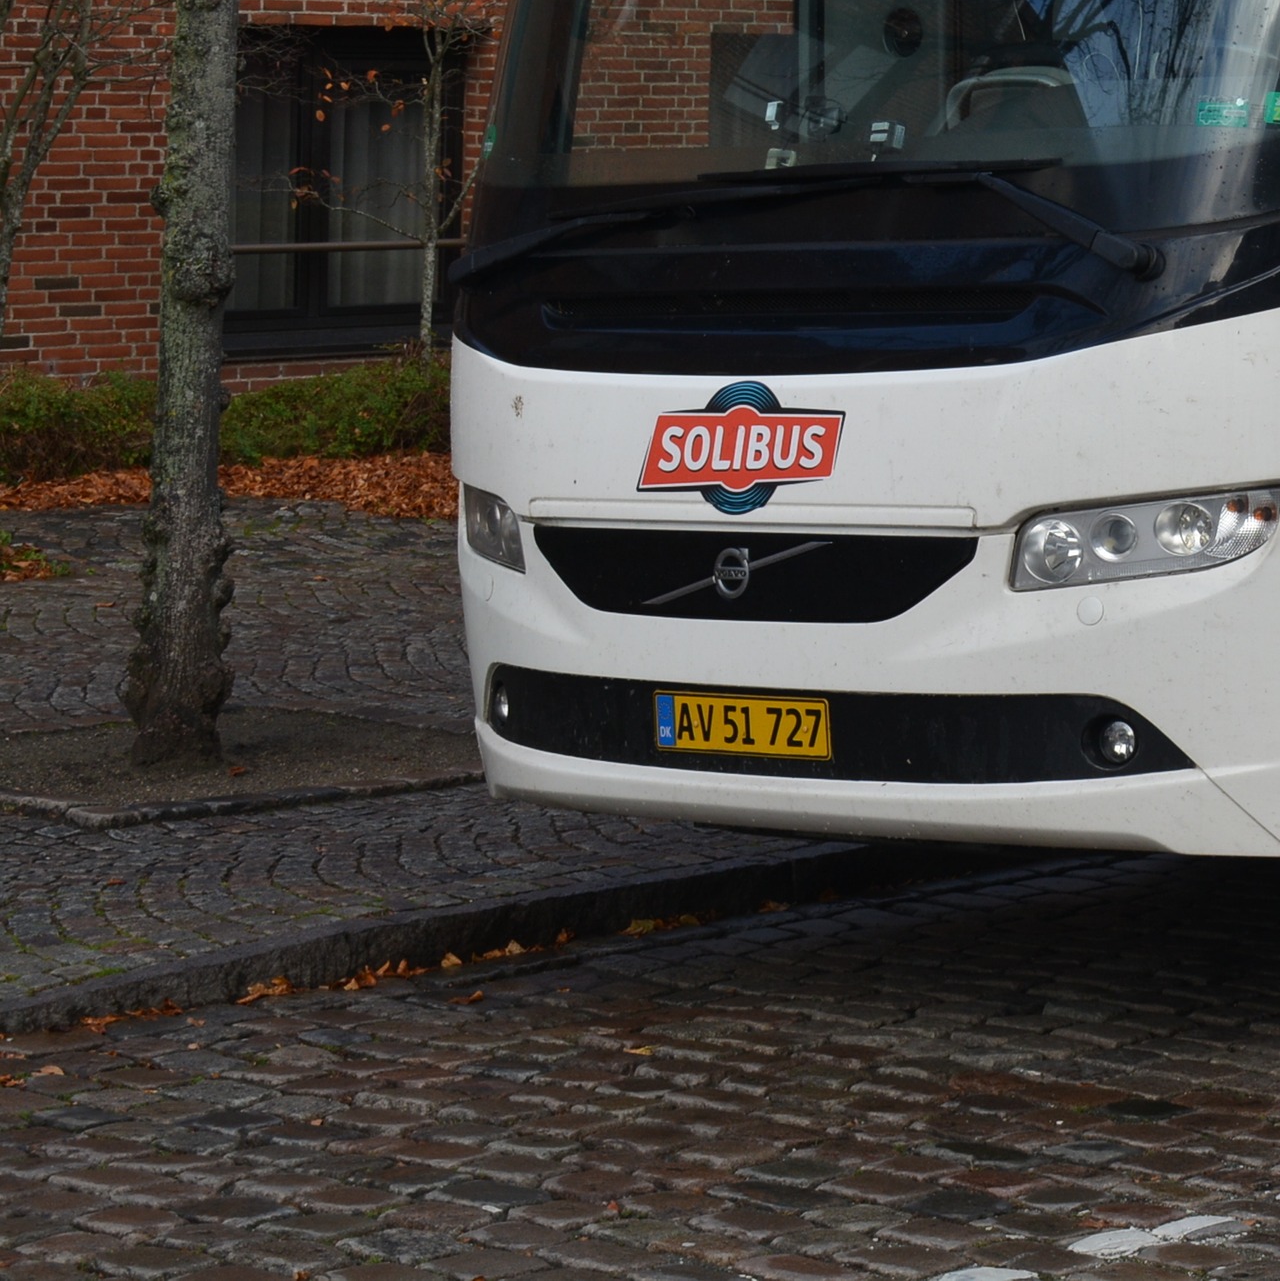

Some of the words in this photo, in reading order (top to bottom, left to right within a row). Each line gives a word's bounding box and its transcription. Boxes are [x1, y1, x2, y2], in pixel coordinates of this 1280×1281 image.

[657, 425, 827, 472] SOLIBUS
[714, 569, 748, 579] VOLVO
[659, 725, 672, 738] DK
[677, 703, 714, 742] AV
[723, 705, 755, 745] 51
[766, 707, 822, 748] 727
